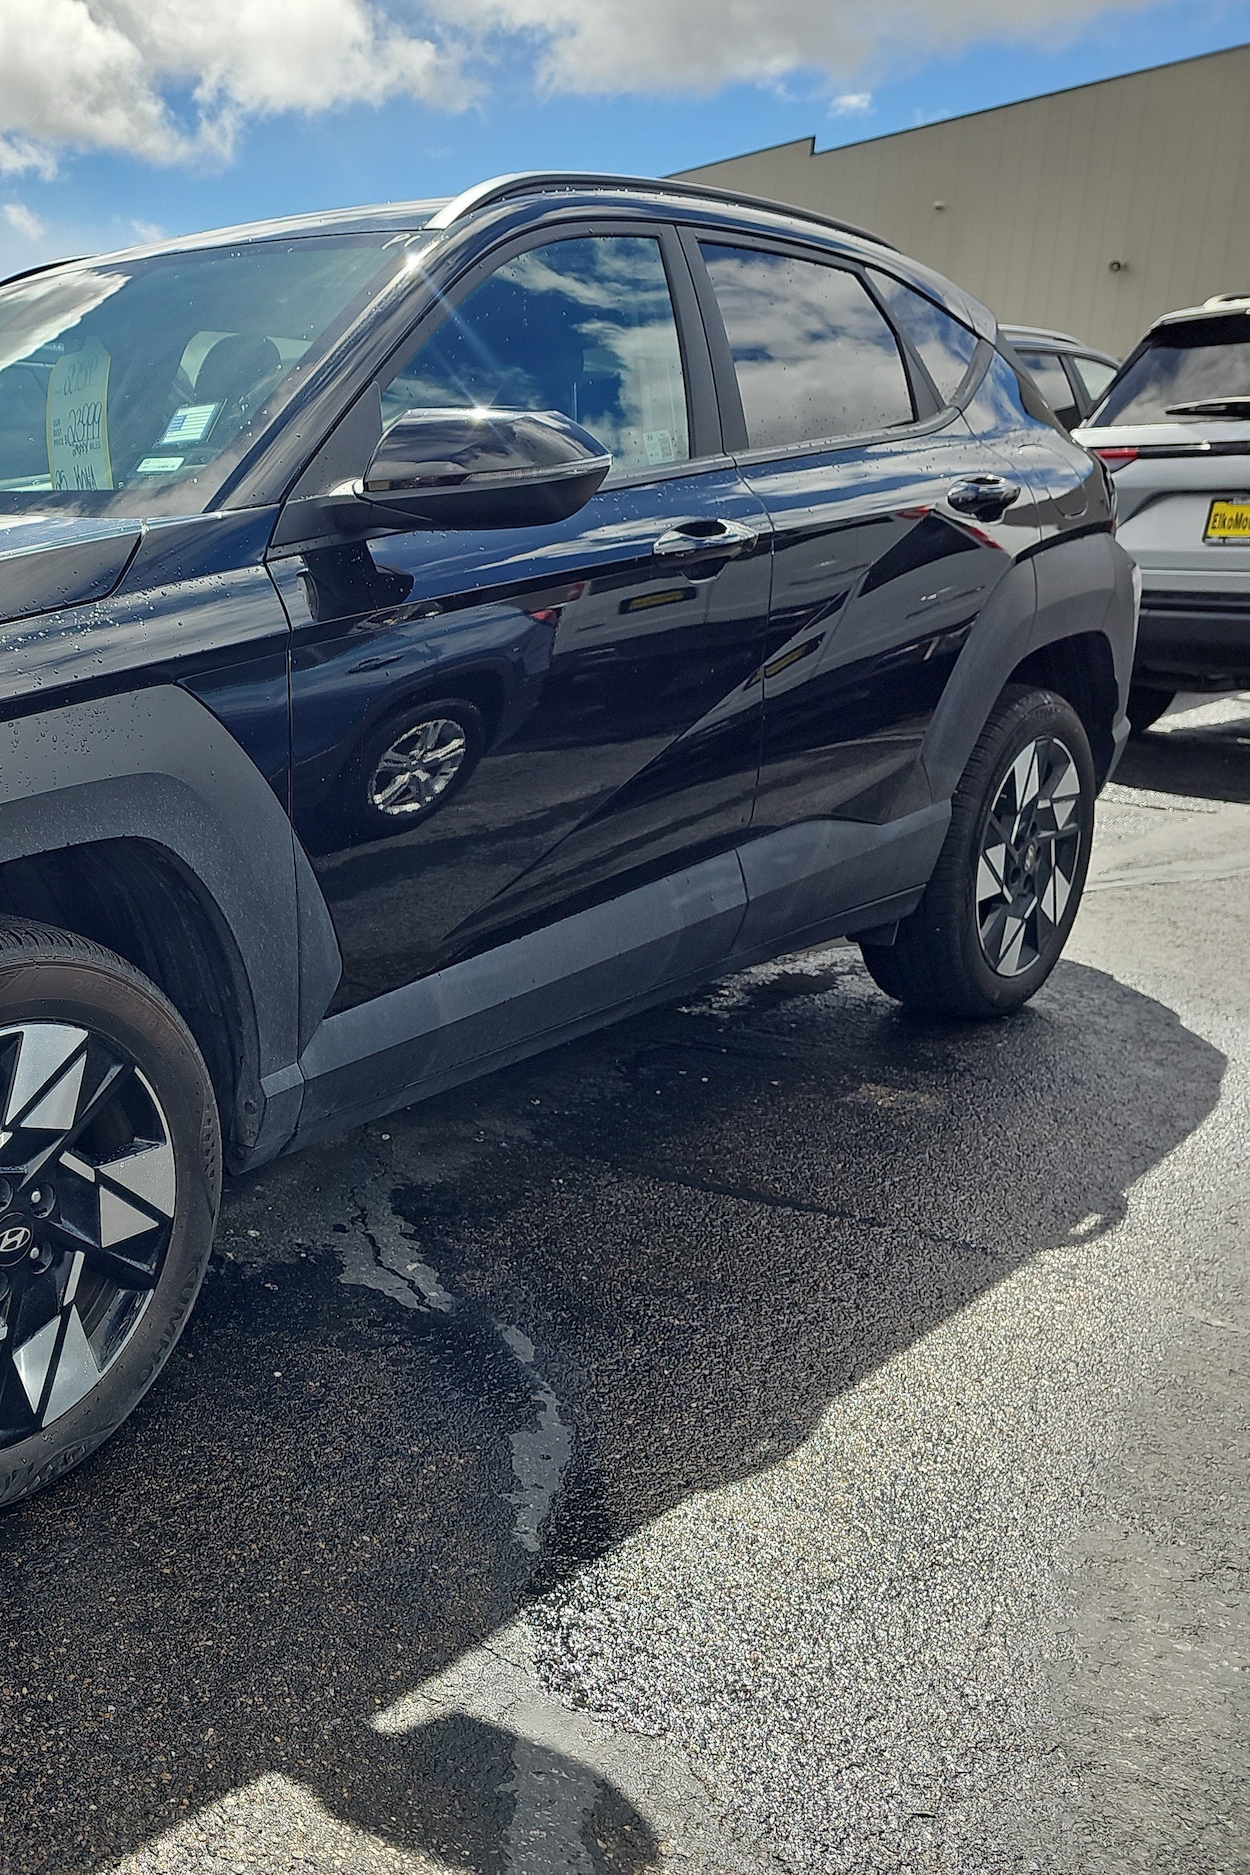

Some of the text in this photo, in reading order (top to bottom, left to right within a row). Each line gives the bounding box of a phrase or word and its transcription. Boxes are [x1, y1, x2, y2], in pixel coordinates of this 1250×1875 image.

[52, 418, 61, 428] OUR
[52, 427, 62, 437] BEST
[53, 437, 64, 447] PRICE
[89, 441, 101, 450] MILES
[1210, 512, 1250, 530] ElkoMo
